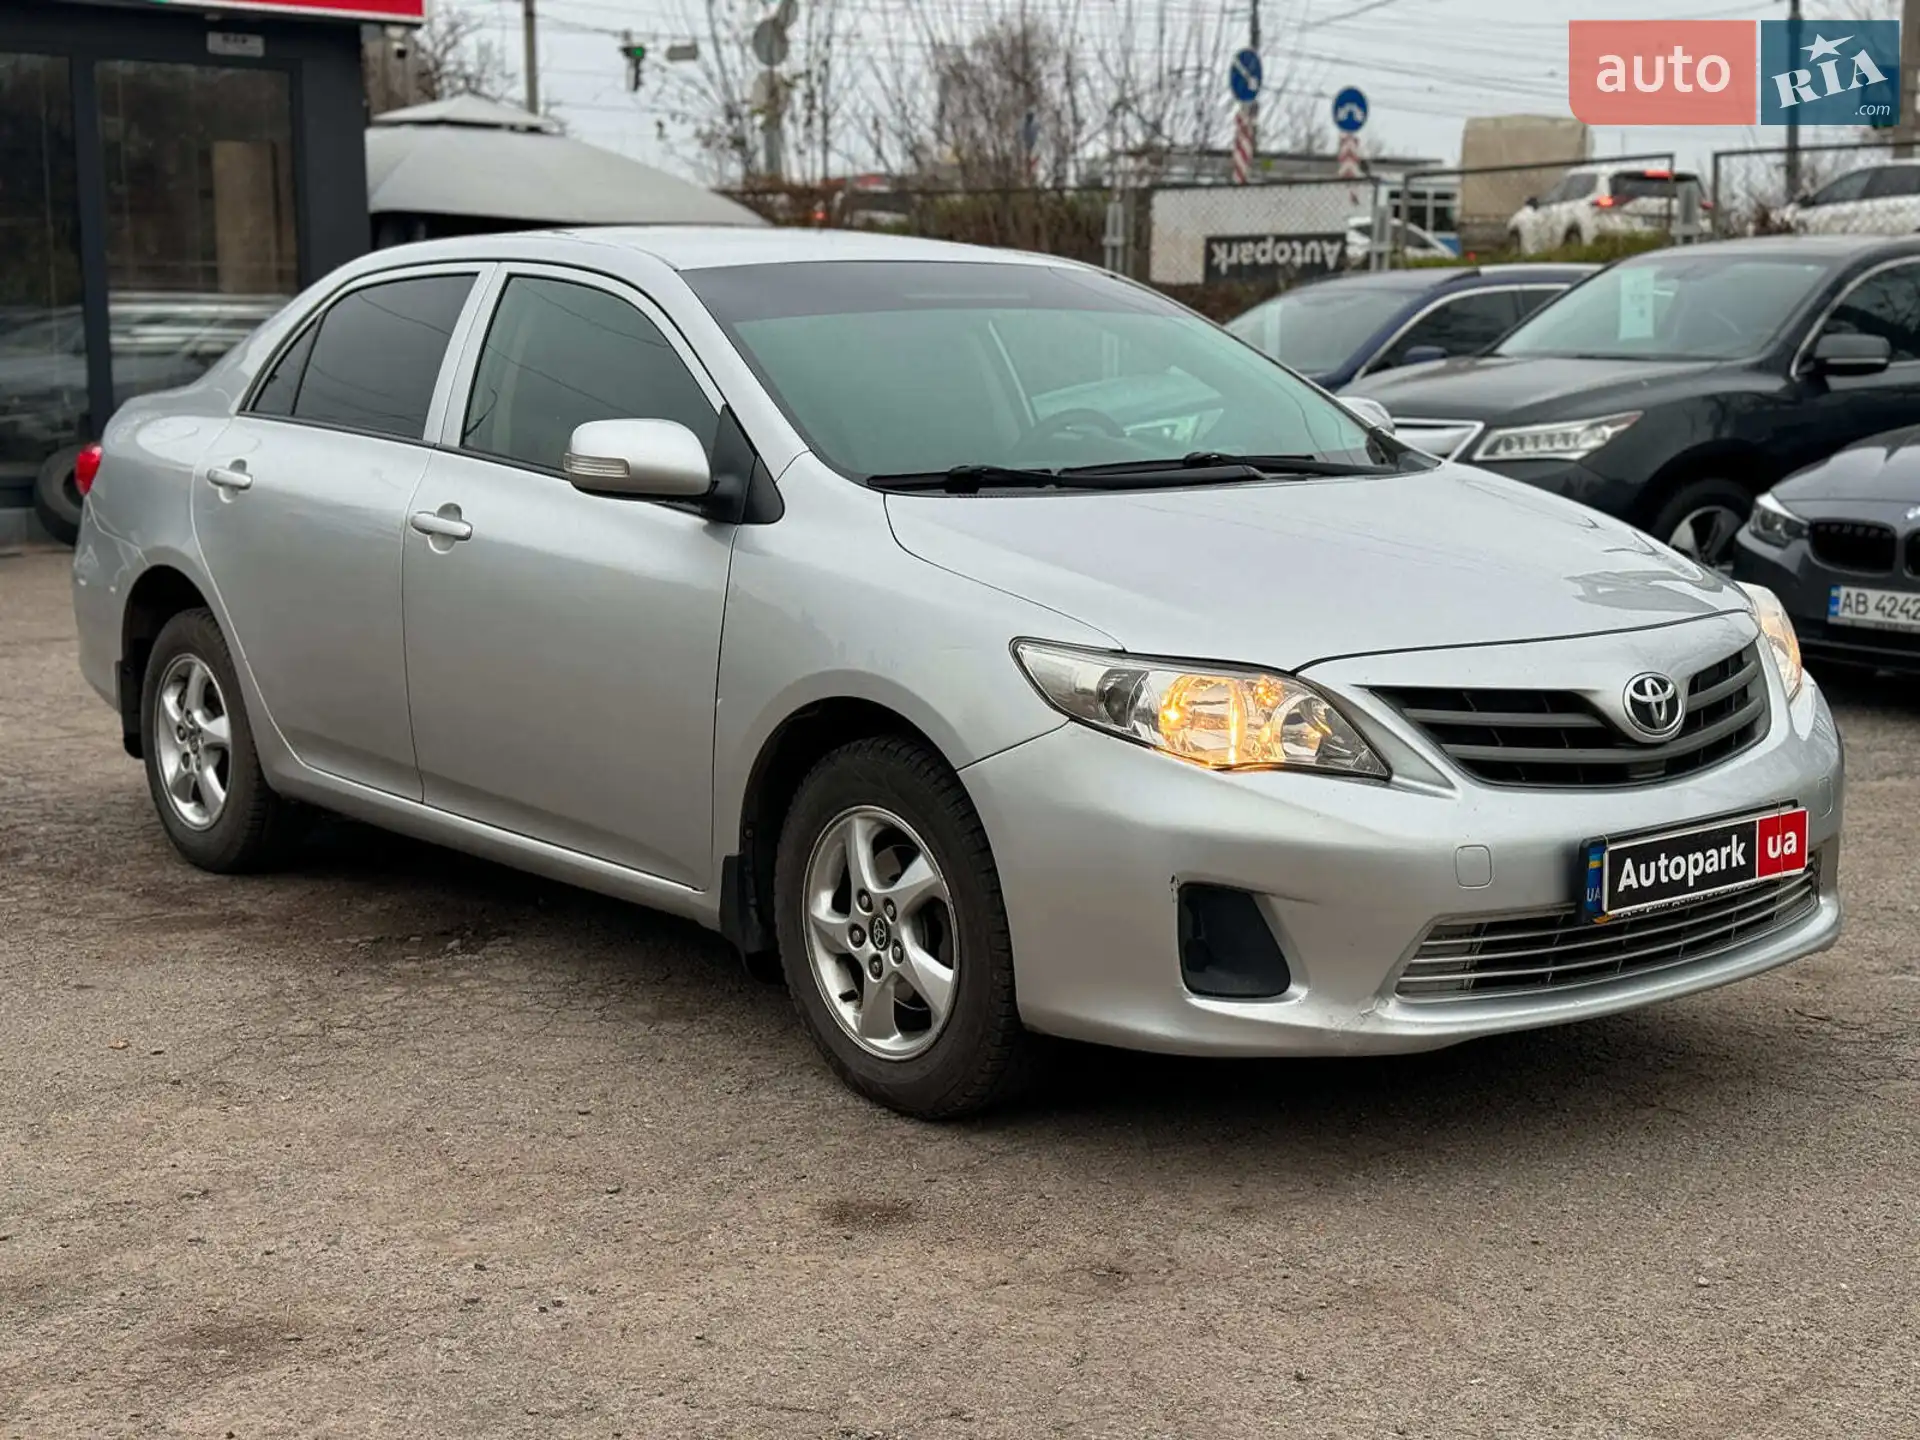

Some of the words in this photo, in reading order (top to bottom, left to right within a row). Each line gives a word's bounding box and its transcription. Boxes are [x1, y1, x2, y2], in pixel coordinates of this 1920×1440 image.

[1211, 235, 1342, 275] Autopark
[1842, 591, 1868, 616] AB
[1874, 594, 1920, 620] 4242
[1617, 834, 1746, 892] Autopark
[1766, 831, 1797, 859] ua
